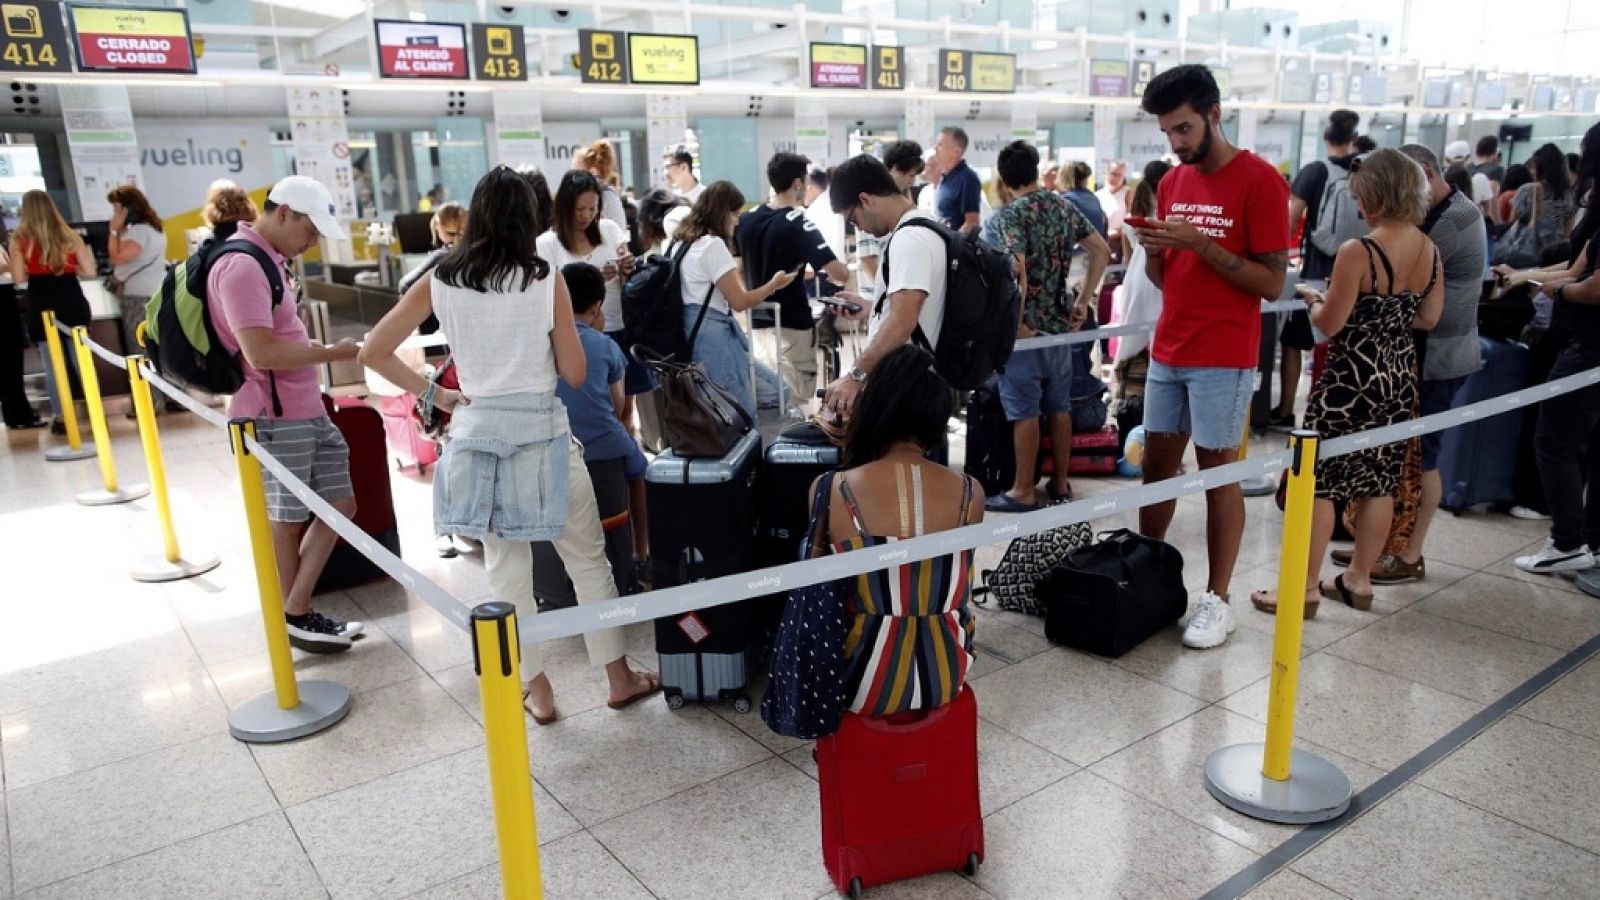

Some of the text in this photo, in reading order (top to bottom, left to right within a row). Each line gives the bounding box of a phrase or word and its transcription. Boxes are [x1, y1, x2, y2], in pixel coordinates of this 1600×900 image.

[97, 38, 171, 51] CERRADO
[642, 44, 685, 61] vueling
[3, 42, 57, 67] 414
[106, 52, 167, 65] CLOSED
[394, 60, 455, 72] AL CLIENT
[484, 57, 520, 78] 413
[588, 61, 622, 80] 412
[878, 71, 900, 88] 411
[944, 74, 966, 90] 410
[1205, 216, 1234, 228] FROM
[748, 575, 783, 590] vueling
[599, 603, 640, 621] vueling
